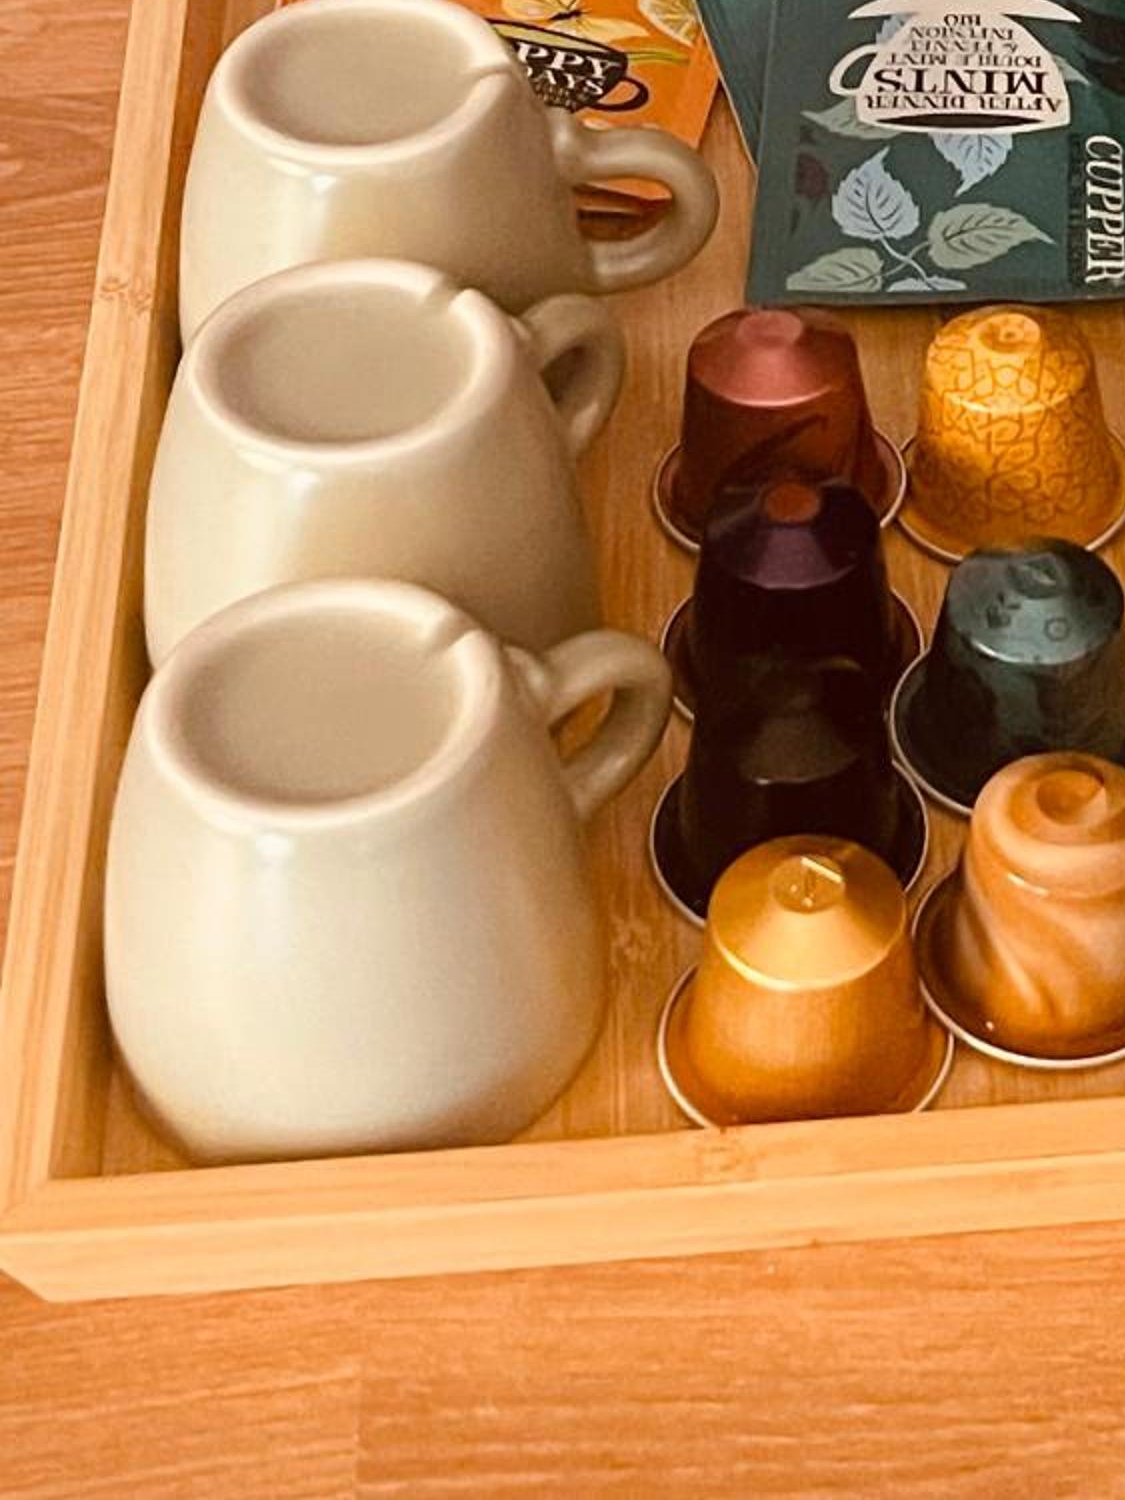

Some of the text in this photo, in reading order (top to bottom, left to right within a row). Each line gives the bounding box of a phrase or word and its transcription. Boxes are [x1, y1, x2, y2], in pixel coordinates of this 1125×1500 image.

[943, 13, 982, 27] BIO
[908, 27, 1014, 40] INFUSION
[885, 53, 1042, 68] DOUBLE MINT
[873, 68, 1050, 95] MINTS
[865, 93, 1062, 113] AFTER DINNER
